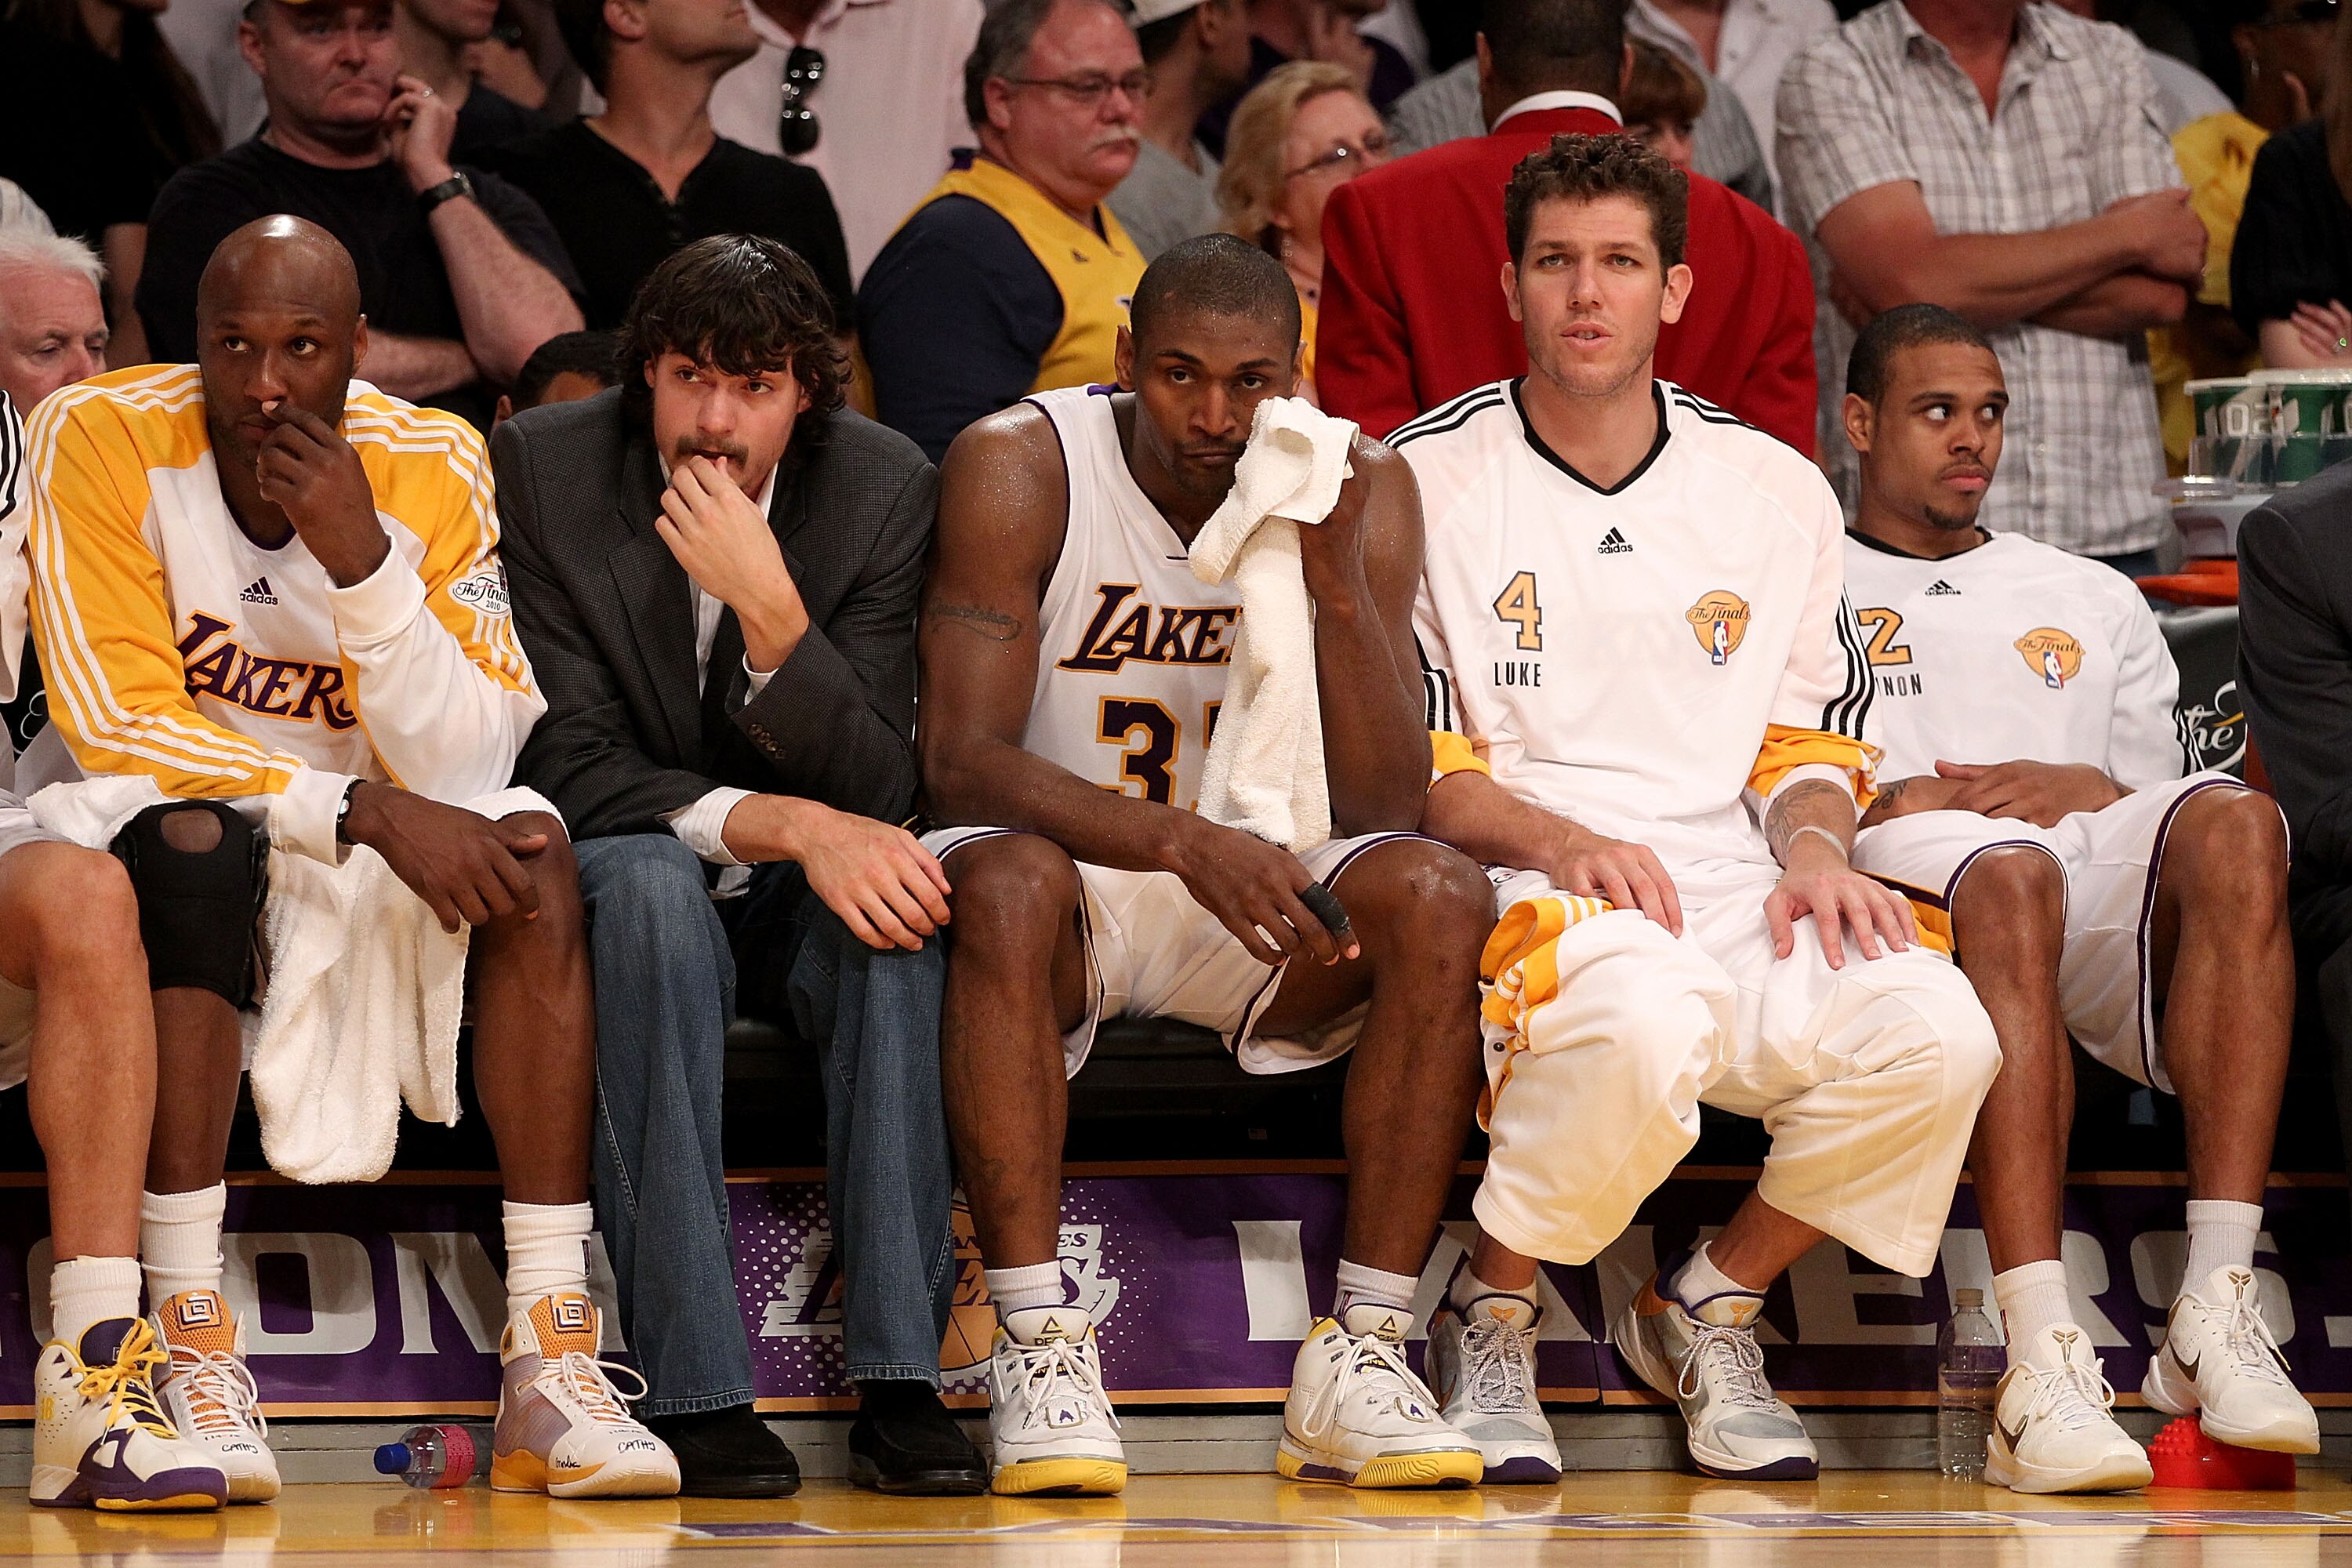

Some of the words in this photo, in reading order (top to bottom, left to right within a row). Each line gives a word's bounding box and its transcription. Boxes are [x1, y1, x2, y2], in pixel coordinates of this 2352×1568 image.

[1597, 543, 1634, 554] adidas
[239, 592, 278, 605] adidas
[455, 582, 480, 597] The
[463, 576, 510, 604] Final
[485, 600, 501, 611] 2010
[1492, 570, 1543, 652] 4
[1699, 601, 1748, 622] Finals
[1054, 583, 1243, 675] LAKE
[174, 609, 358, 733] LAKER
[1494, 662, 1541, 688] LUKE
[1875, 673, 1922, 697] NON
[1096, 695, 1223, 814] 3
